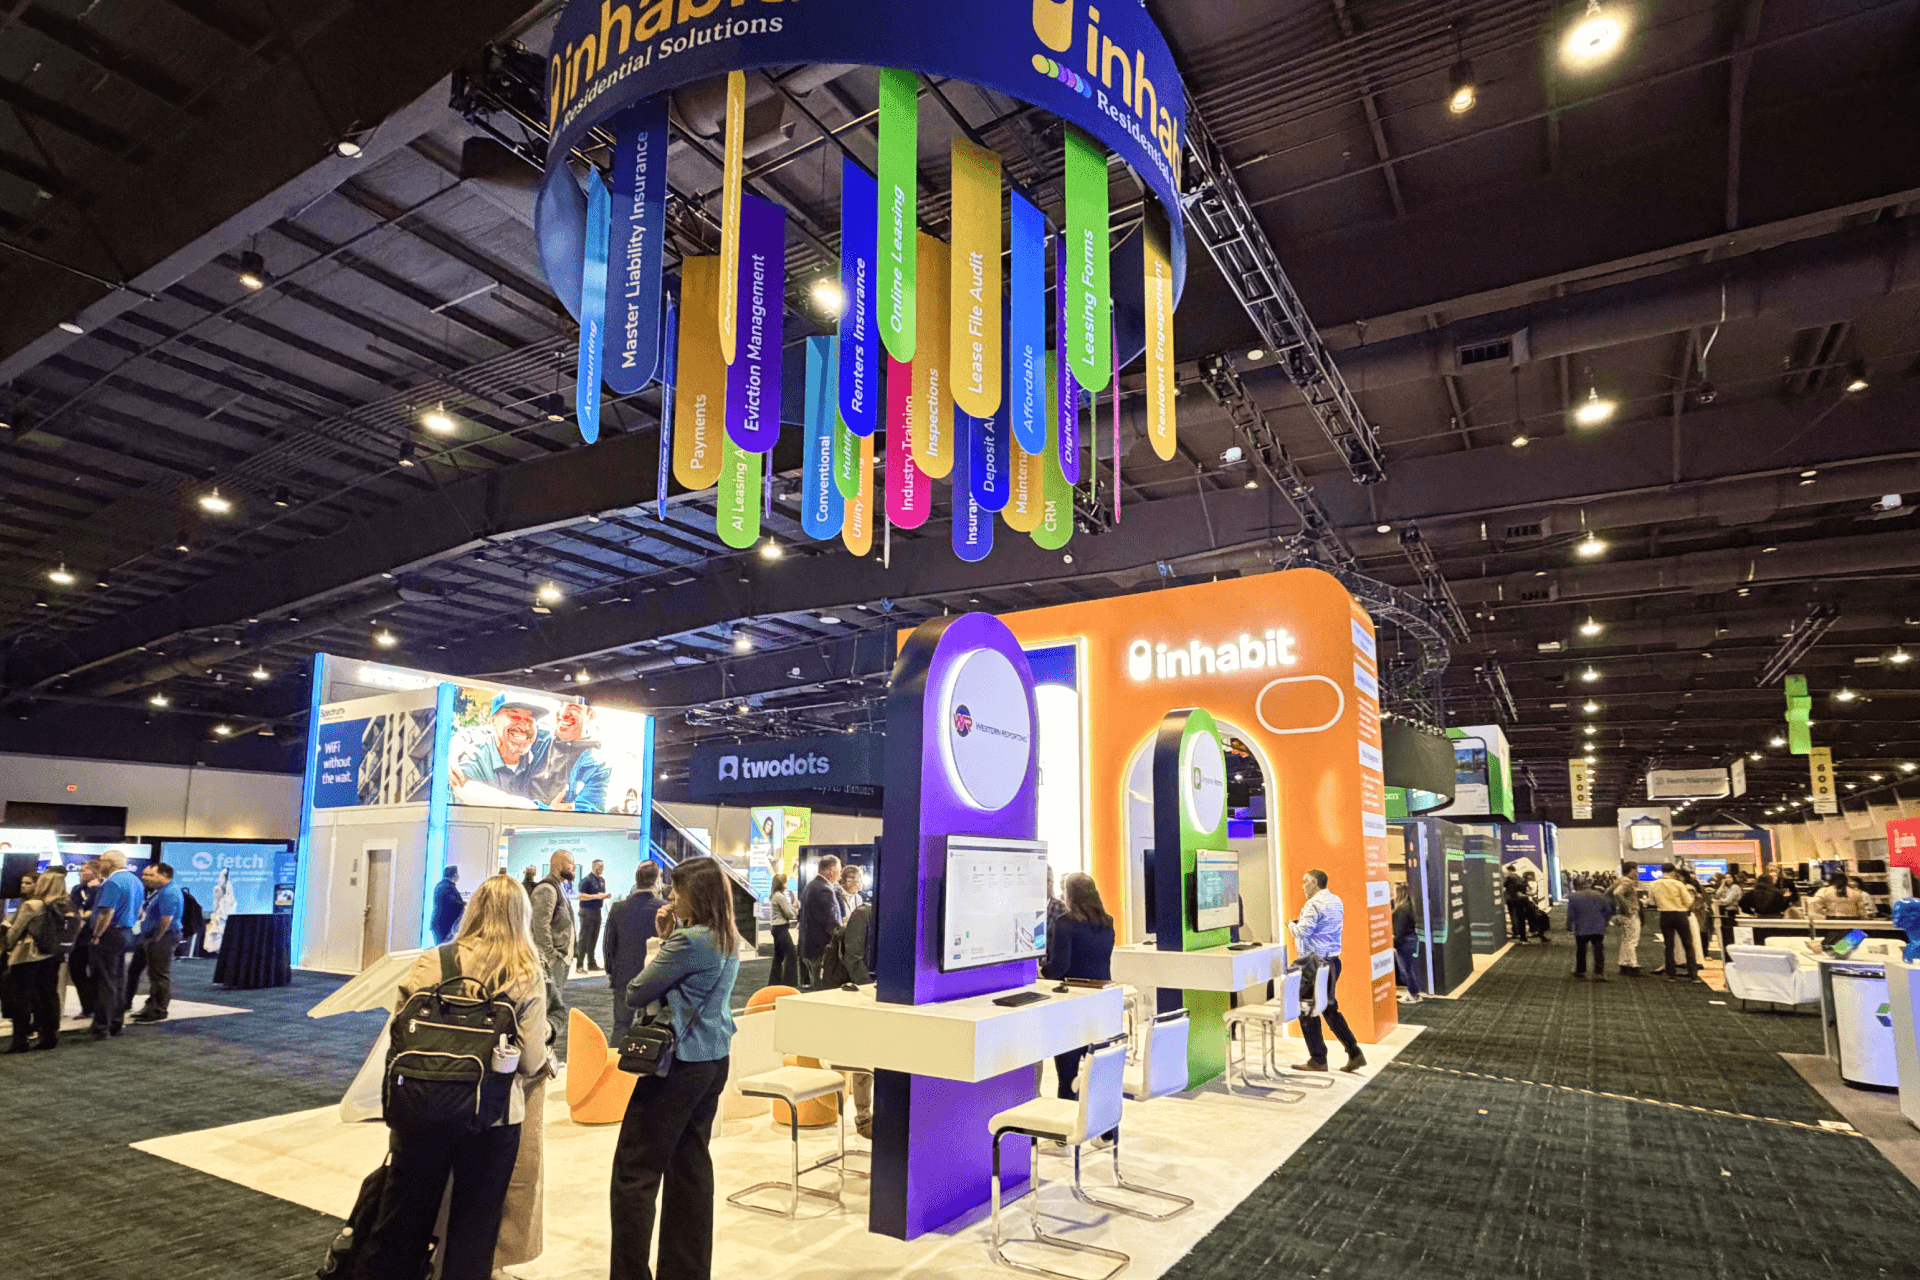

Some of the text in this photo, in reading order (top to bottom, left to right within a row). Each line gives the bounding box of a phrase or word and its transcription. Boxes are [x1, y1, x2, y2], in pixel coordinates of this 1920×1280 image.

[562, 0, 800, 112] inha
[563, 17, 783, 130] Residential Solutions
[1097, 89, 1170, 184] Residential
[621, 131, 649, 368] Master Liability Insurance
[890, 185, 905, 333] Online Leasing
[968, 251, 984, 394] Lease File Audit
[1082, 229, 1098, 366] Leasing Forms
[744, 254, 767, 432] Eviction Management
[851, 258, 866, 414] Renters Insurance
[1155, 261, 1167, 438] Resident Engagement
[584, 319, 597, 420] Accounting
[1022, 344, 1034, 434] Affordable
[690, 394, 708, 469] Payments
[926, 368, 940, 457] Inspections
[1064, 411, 1073, 465] Digital
[731, 463, 747, 512] Leasing
[816, 436, 831, 522] Conventional
[900, 453, 914, 511] Industry
[983, 435, 997, 493] Deposit
[731, 516, 743, 531] AI
[853, 499, 864, 538] Utility
[966, 491, 978, 545] Insuran
[1044, 500, 1057, 532] CRM
[1157, 630, 1296, 678] inhabit
[324, 740, 341, 754] WiFi
[976, 721, 1001, 736] WESTERN
[322, 771, 335, 785] the
[323, 756, 352, 769] without
[741, 752, 829, 779] twodots
[216, 853, 264, 869] fetch
